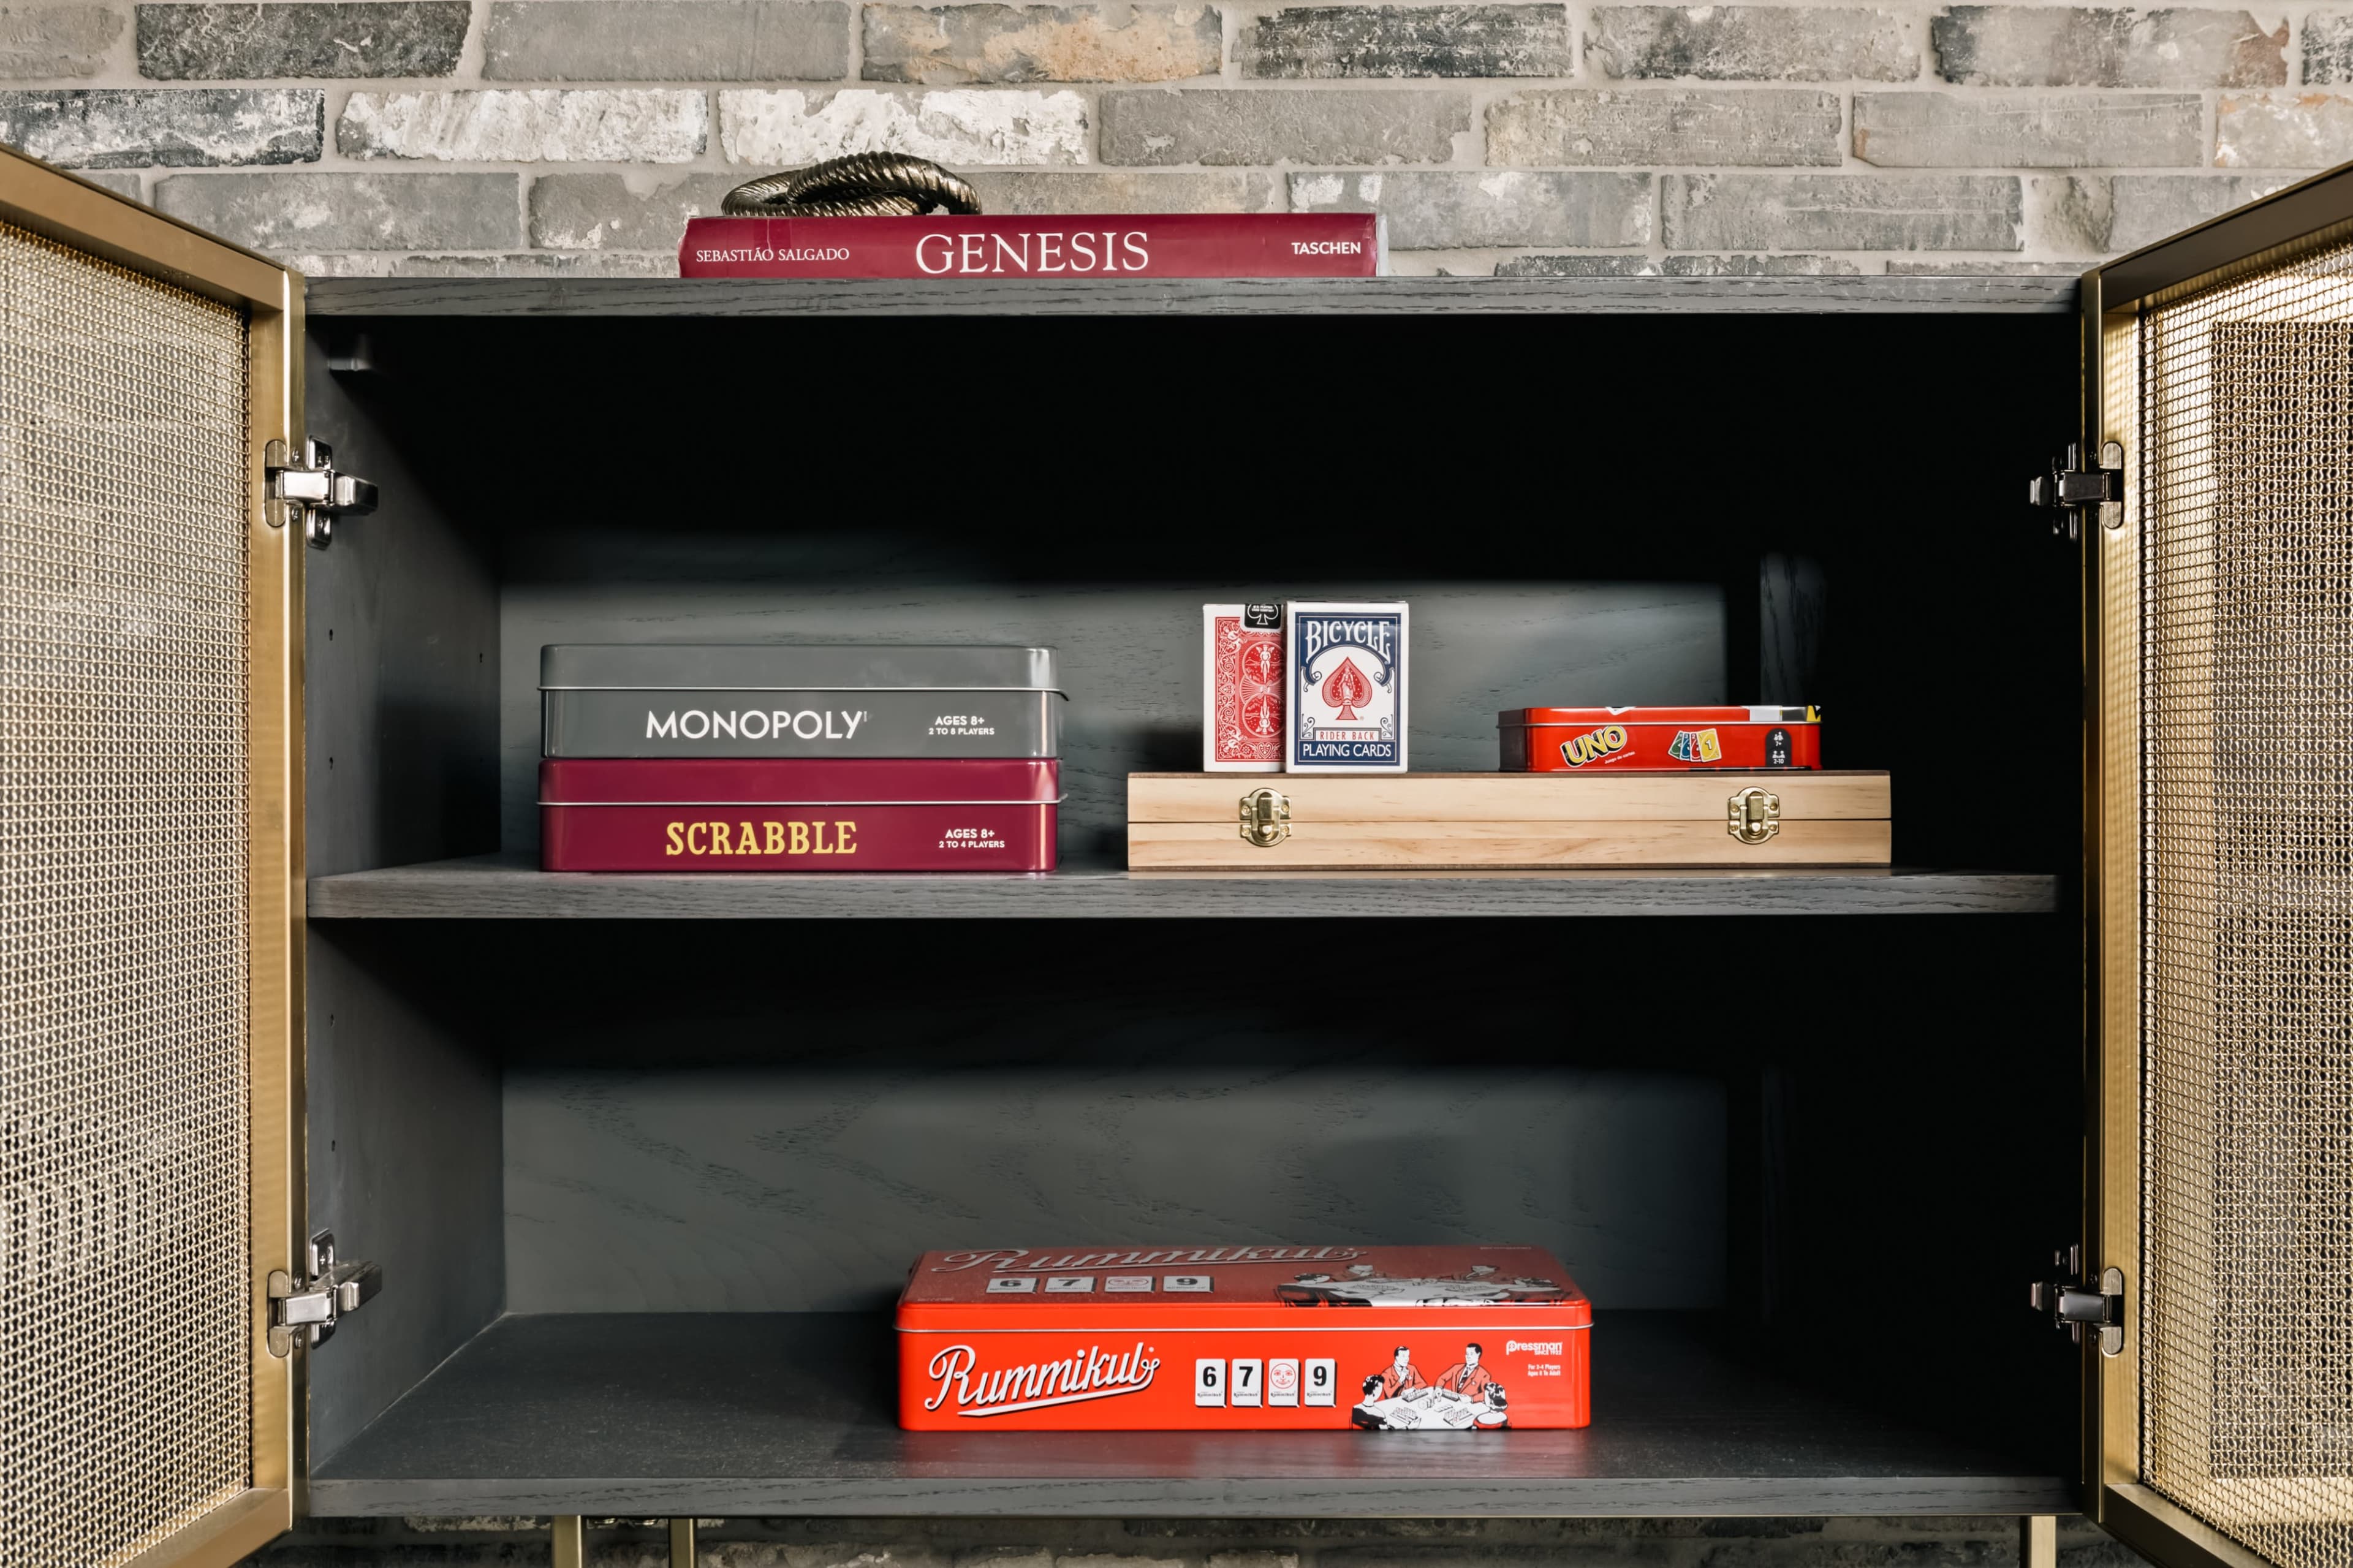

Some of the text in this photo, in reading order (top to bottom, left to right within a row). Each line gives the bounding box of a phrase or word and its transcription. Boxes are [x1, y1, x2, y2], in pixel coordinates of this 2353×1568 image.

[778, 248, 850, 261] SALGADO
[916, 232, 1149, 274] GENESIS
[1291, 241, 1361, 255] TASCHEN
[1305, 620, 1391, 665] BICYCLE
[646, 710, 862, 740] MONOPOLY
[934, 716, 985, 725] AGES 8+
[1320, 731, 1374, 740] RIDER BACK
[1561, 725, 1627, 767] UNO
[1706, 740, 1712, 749] 1
[1303, 743, 1392, 757] PLAYING CARDS
[666, 821, 857, 855] SCRABBLE
[945, 828, 995, 839] AGES 8+
[931, 1246, 1368, 1273] Rummikub
[924, 1342, 1161, 1417] Rummikub
[1202, 1365, 1327, 1387] 6 7 9
